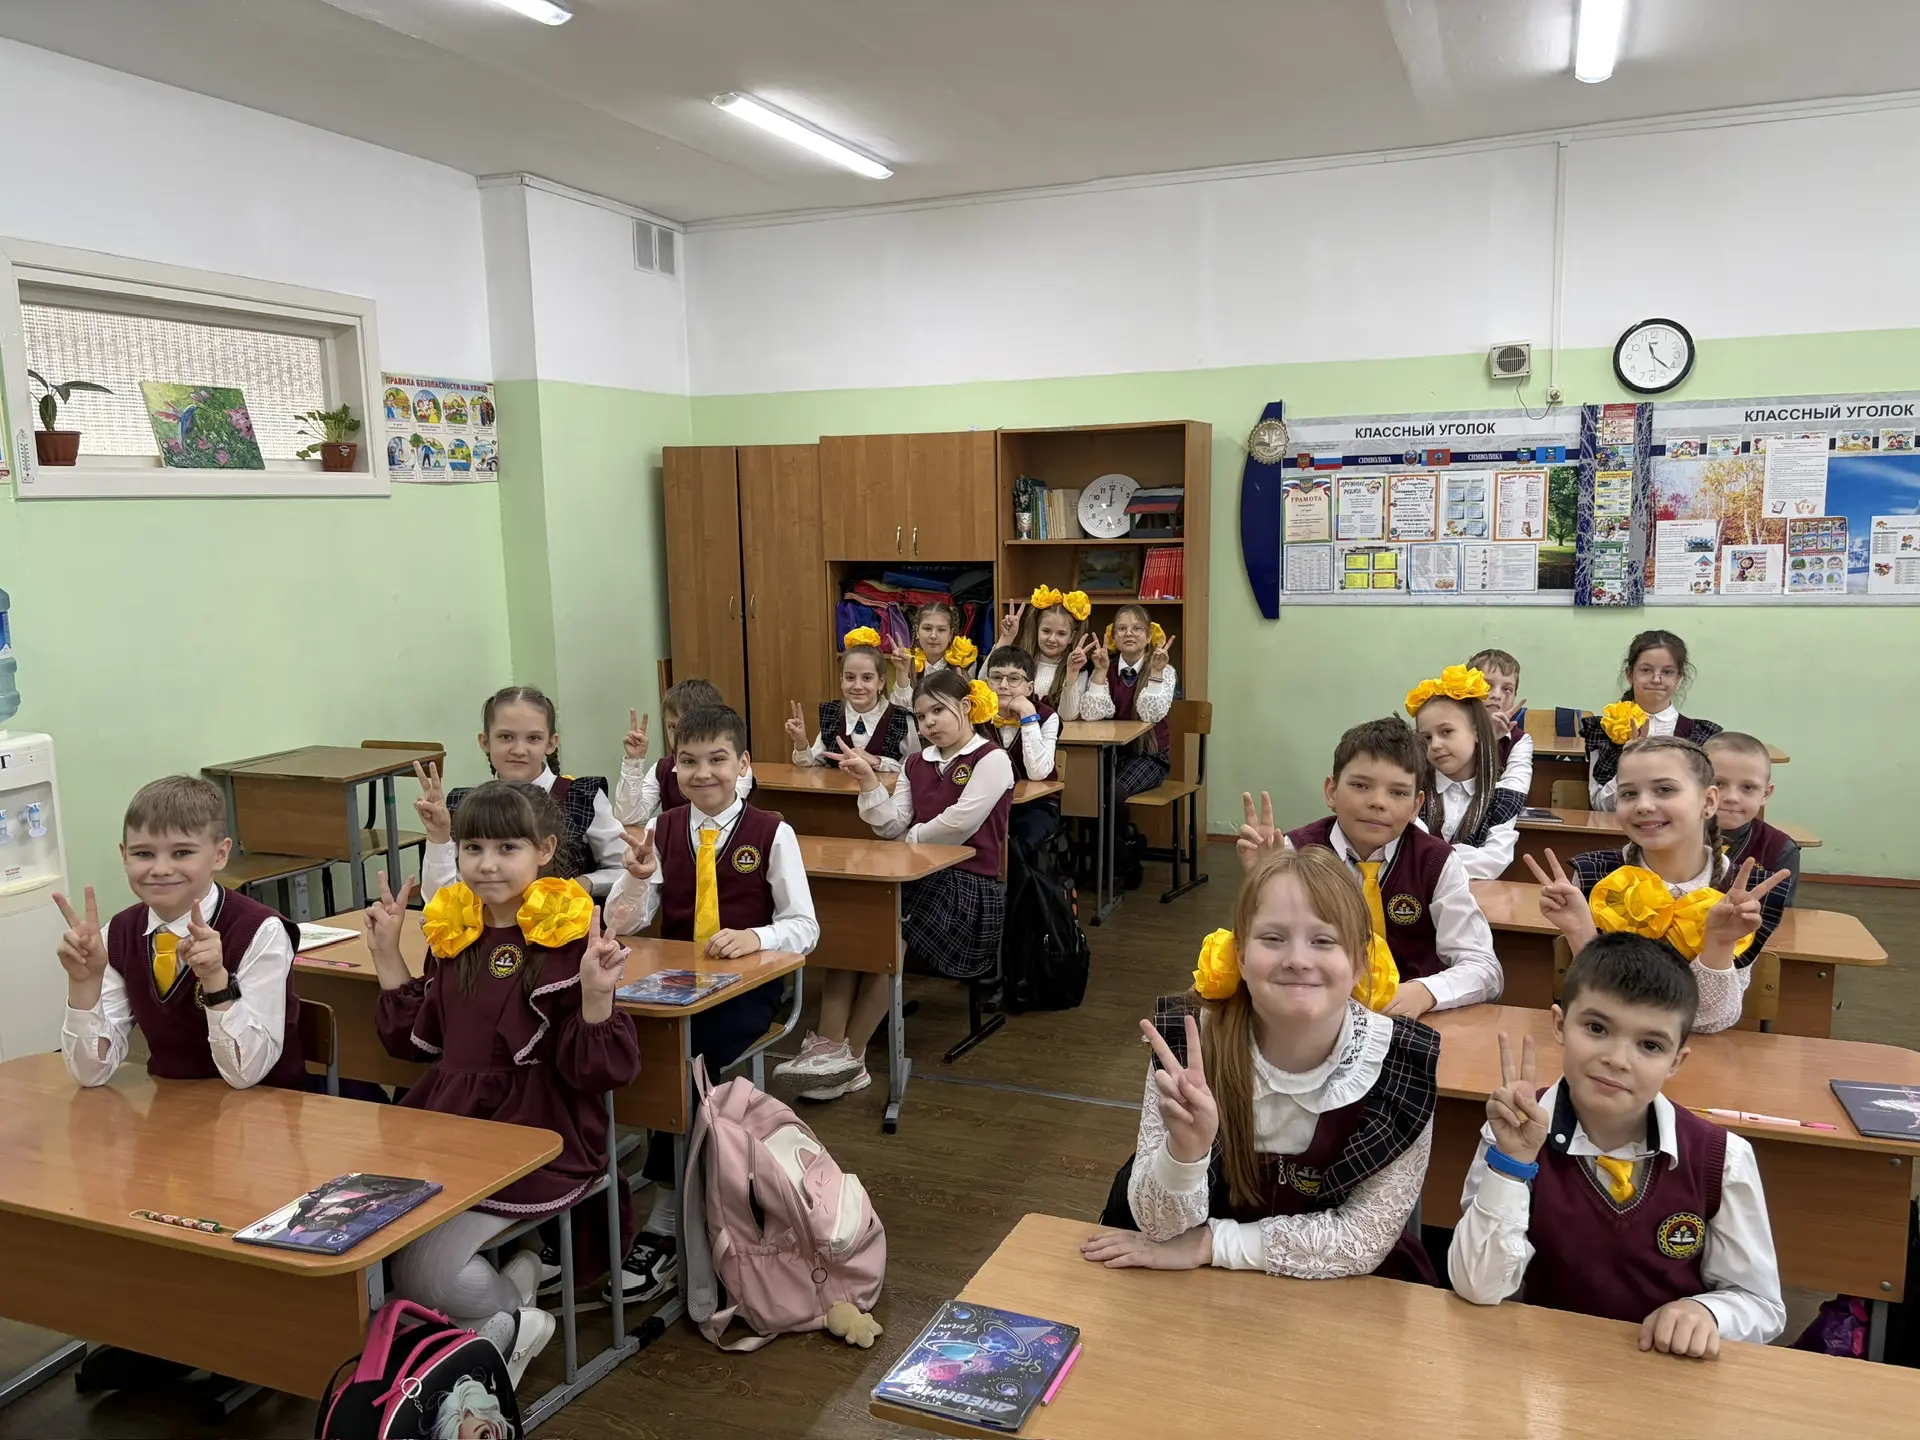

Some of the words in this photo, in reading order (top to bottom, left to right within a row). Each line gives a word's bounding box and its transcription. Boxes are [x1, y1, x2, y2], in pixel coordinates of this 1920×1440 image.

[386, 376, 415, 387] ПРАВИЛА
[416, 380, 461, 391] БЕЗОПАСНОСТИ
[1744, 405, 1840, 422] КЛАССНЫЙ
[1846, 403, 1914, 419] УГОЛОК
[1355, 423, 1435, 438] КЛАССНЫЙ
[1440, 422, 1496, 436] УГОЛОК
[1358, 455, 1392, 464] СИМВОЛИКА
[1467, 452, 1503, 461] СИМВОЛИКА
[1290, 495, 1322, 503] ГРАМОТА
[905, 1383, 1018, 1413] ДНЕВНИК
